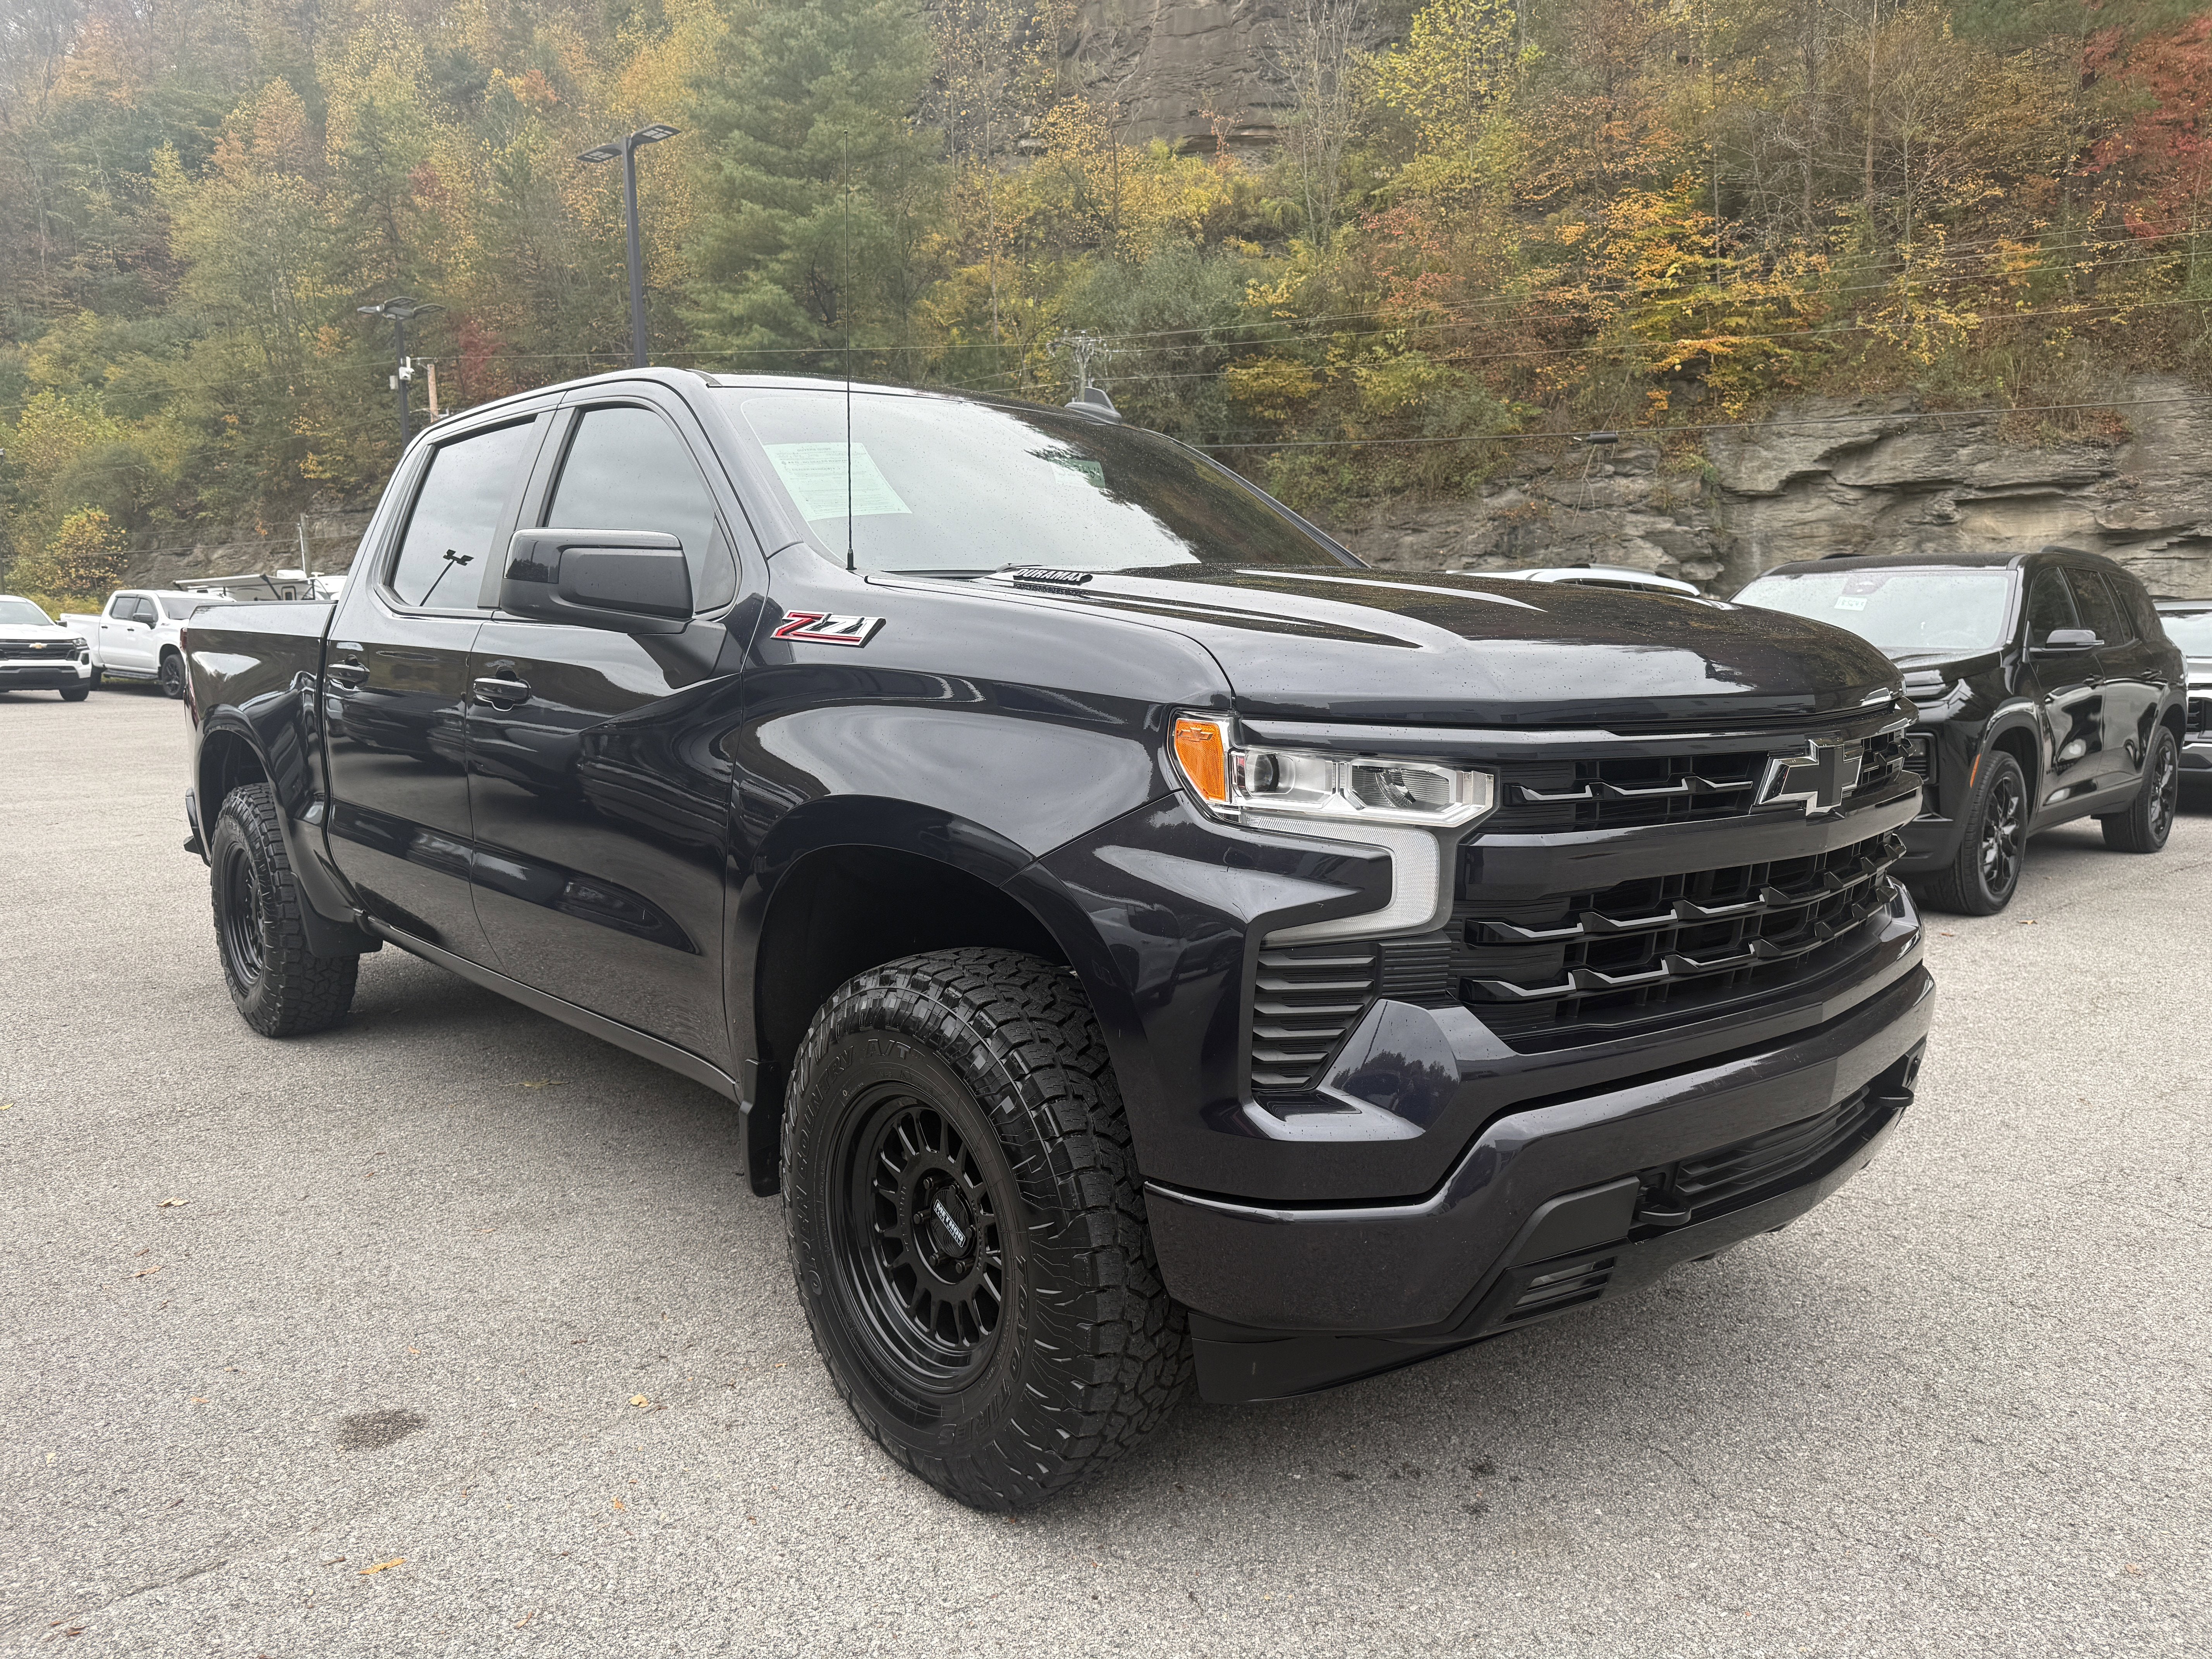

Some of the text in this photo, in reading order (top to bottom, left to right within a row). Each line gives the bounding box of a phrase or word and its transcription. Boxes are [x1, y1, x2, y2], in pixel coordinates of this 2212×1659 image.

[1014, 568, 1087, 583] DURAMAX
[770, 610, 886, 648] Z71
[797, 1045, 854, 1180] COUNTRY
[864, 1038, 911, 1060] A/T
[936, 1201, 964, 1242] METHOD
[1010, 1255, 1029, 1382] TOYO
[939, 1378, 1011, 1445] TIRES
